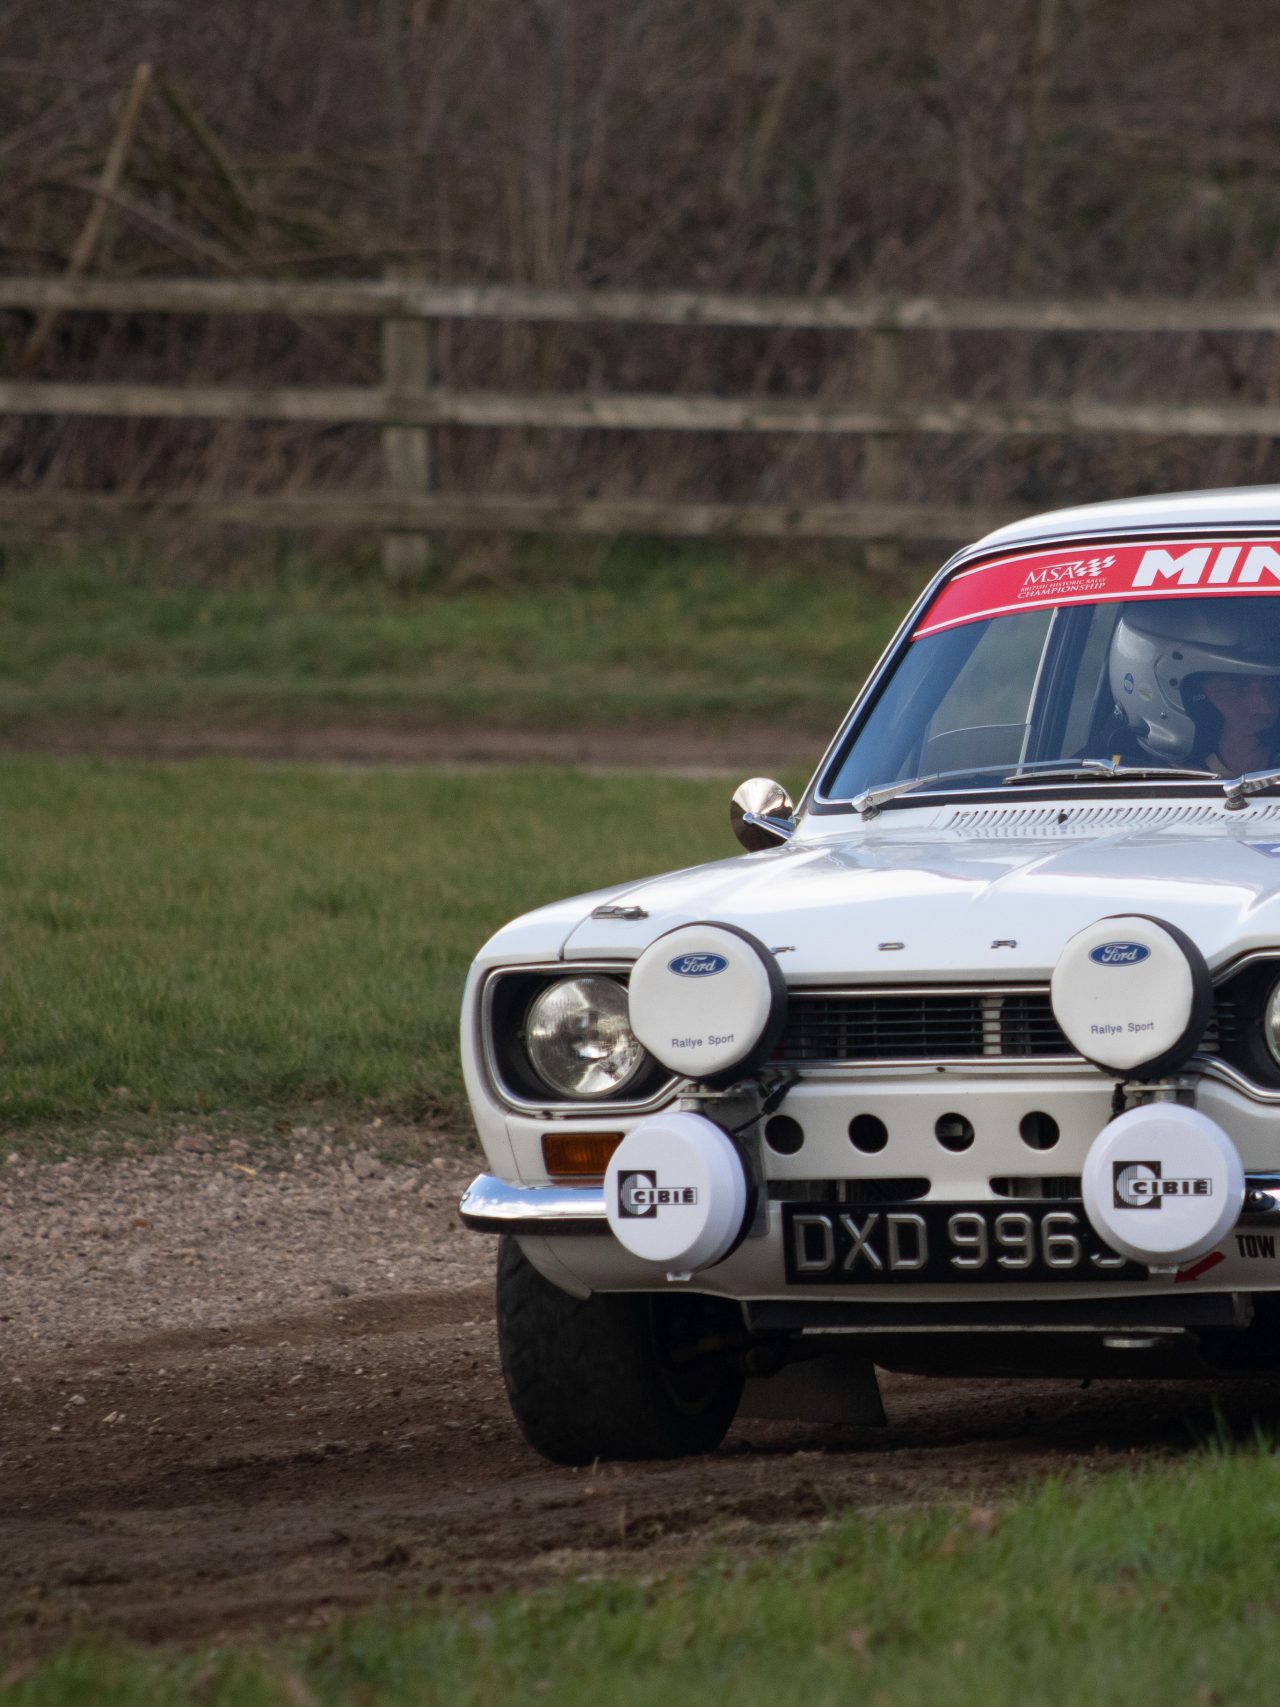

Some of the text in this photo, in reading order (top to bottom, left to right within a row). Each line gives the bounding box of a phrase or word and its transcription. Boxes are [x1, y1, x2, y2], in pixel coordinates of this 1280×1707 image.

[1023, 566, 1076, 586] MSA
[1017, 582, 1106, 599] CHAMPIONSHIP
[1101, 945, 1138, 962] Ford
[680, 955, 717, 973] Ford
[1090, 1022, 1155, 1036] Rallye Sport
[671, 1034, 735, 1049] Rallye Sport
[791, 1211, 1129, 1272] DXD 996
[1235, 1233, 1276, 1259] TOW
